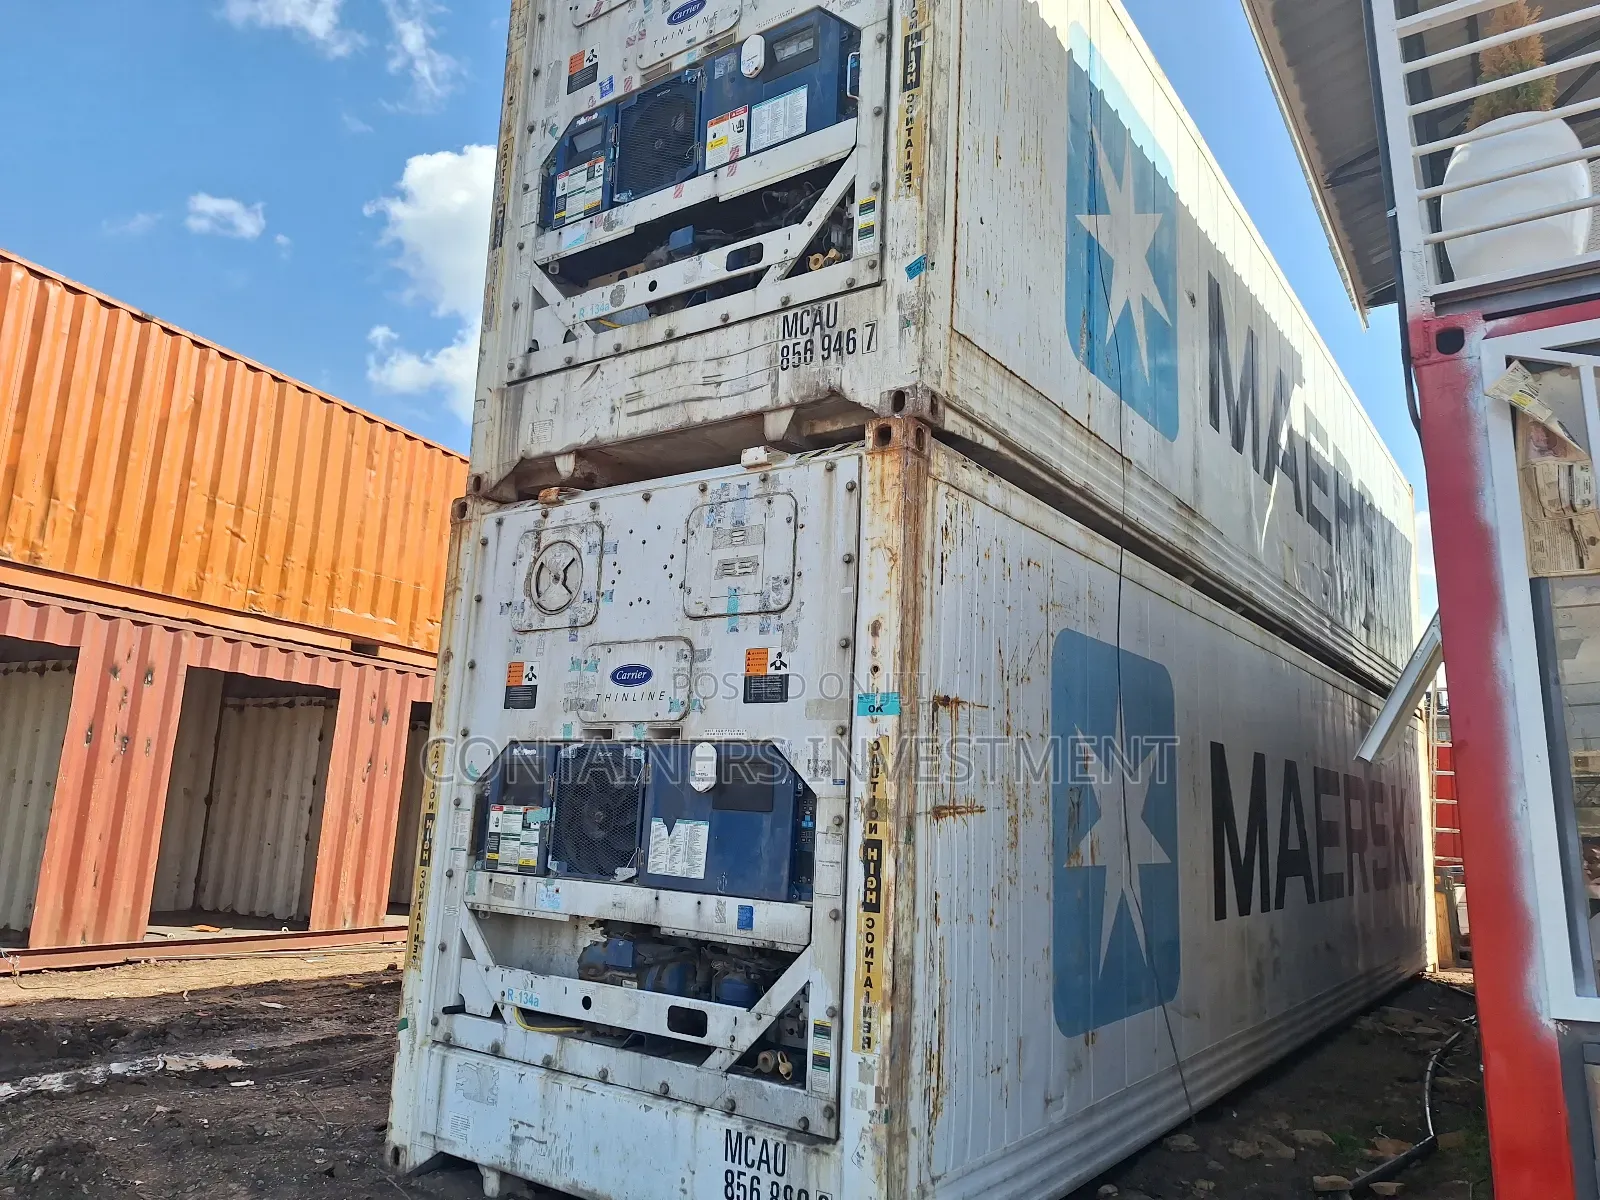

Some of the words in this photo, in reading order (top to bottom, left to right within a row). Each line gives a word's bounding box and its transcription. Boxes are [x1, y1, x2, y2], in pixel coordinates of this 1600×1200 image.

[671, 2, 702, 21] Carrier
[652, 10, 719, 49] THINLINE
[782, 301, 838, 340] MCAU
[780, 338, 815, 372] 856
[821, 327, 857, 361] 946
[863, 321, 877, 353] 7
[616, 670, 647, 681] Carrier
[595, 690, 666, 703] THINLINE
[867, 704, 884, 714] OK
[1209, 740, 1414, 923] MAERSK
[724, 1128, 787, 1178] MCAU
[723, 1168, 762, 1200] 856
